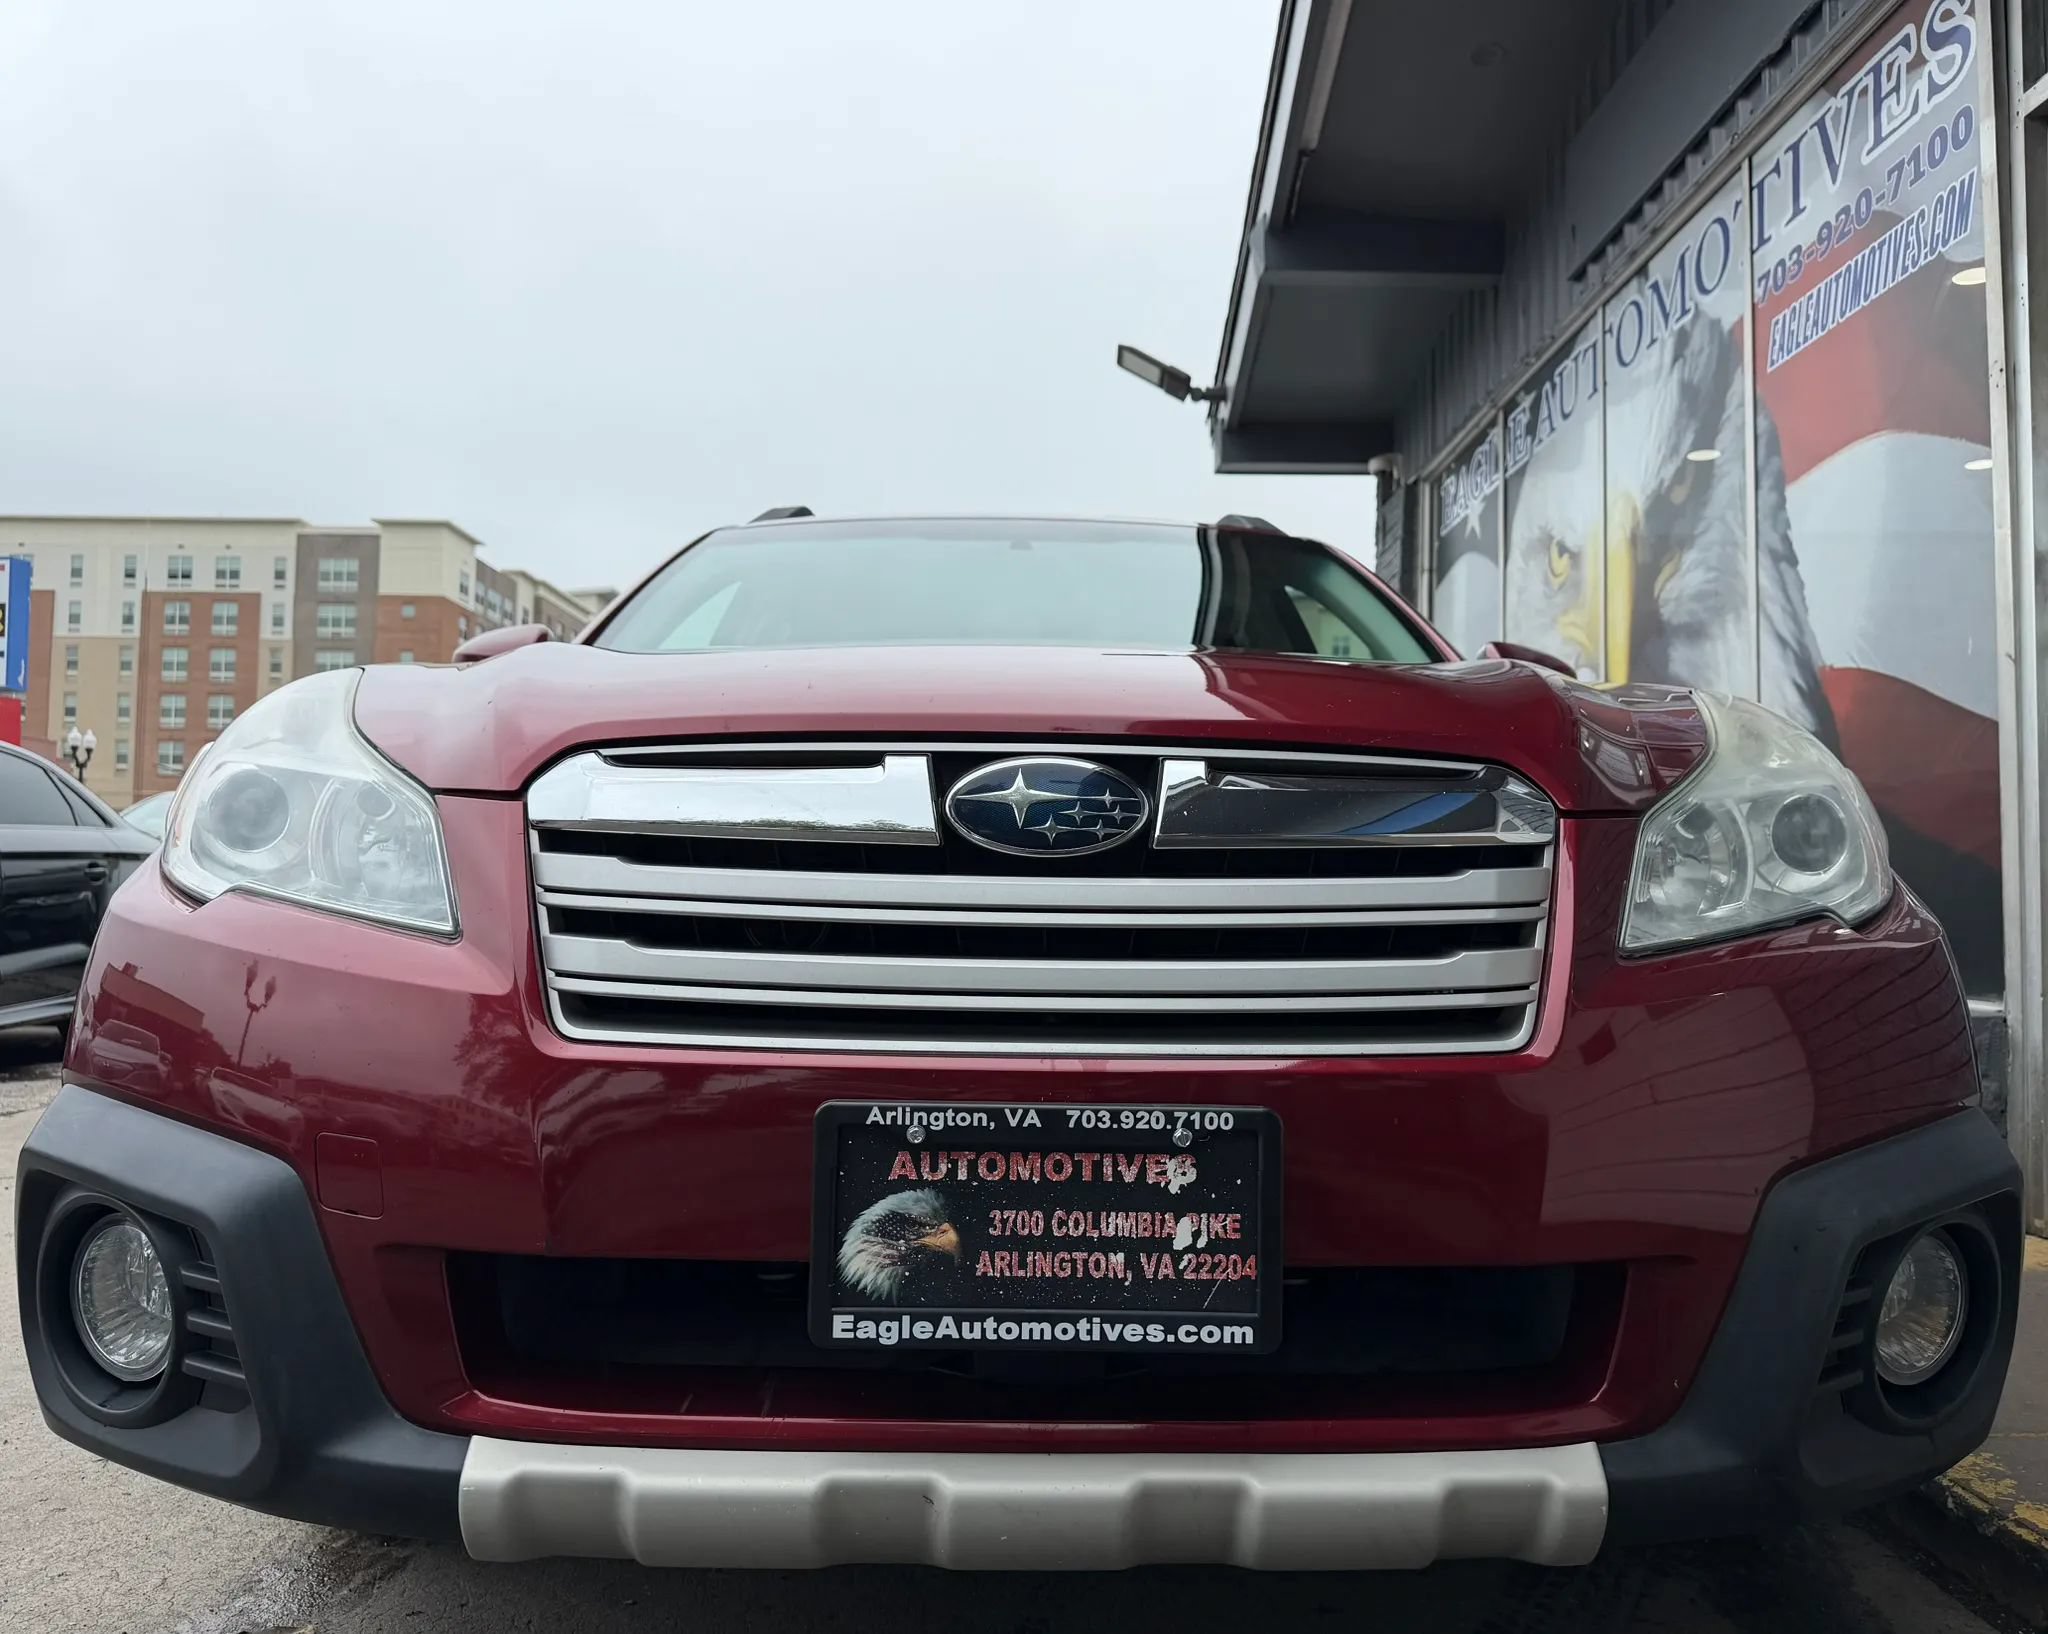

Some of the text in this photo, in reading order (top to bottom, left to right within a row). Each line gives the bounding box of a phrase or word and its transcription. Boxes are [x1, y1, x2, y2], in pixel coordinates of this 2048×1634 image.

[1756, 104, 1974, 305] 703-920-7100
[1440, 0, 1977, 536] EAGLE AUTOMOTIVES
[1768, 167, 1977, 373] EAGLEAUTOMOTIVES.COM
[866, 1106, 1234, 1130] Arlington, VA 703.920.7100
[989, 1210, 1043, 1237] 3700
[1052, 1212, 1177, 1238] COLUMBIA
[976, 1251, 1257, 1284] ARLINGTON, VA 22204
[833, 1315, 1254, 1345] EagleAutomotives.com
